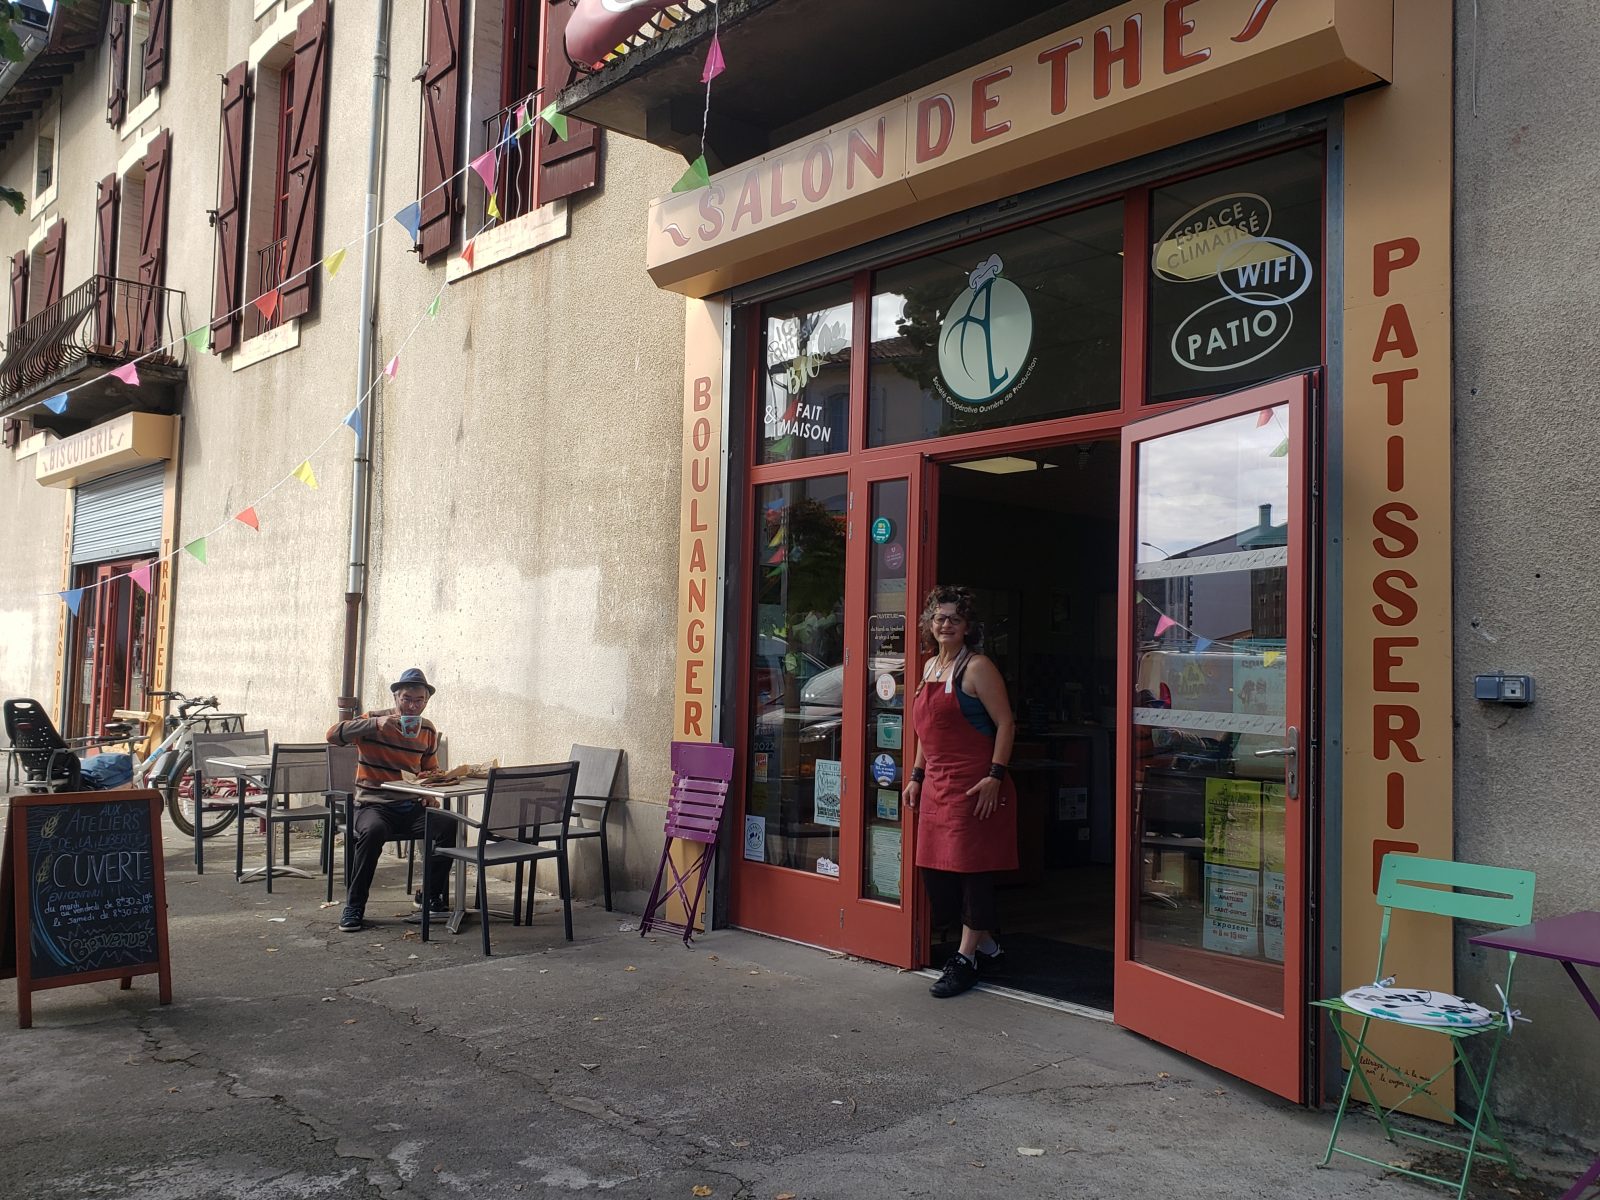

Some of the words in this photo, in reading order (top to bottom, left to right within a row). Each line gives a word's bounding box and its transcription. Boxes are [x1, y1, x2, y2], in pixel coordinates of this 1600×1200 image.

[698, 116, 887, 244] SALON
[916, 65, 1013, 165] DE
[1174, 201, 1245, 247] ESPACE
[1166, 210, 1261, 270] CLIMATISÉ
[1237, 254, 1297, 290] WIFI
[1187, 309, 1278, 361] PATIO
[785, 348, 822, 396] BIO
[932, 375, 948, 399] Société
[945, 396, 979, 415] Coopérative
[1004, 392, 1014, 403] de
[1012, 356, 1039, 395] Production
[763, 404, 777, 425] &
[795, 402, 823, 421] FAIT
[779, 418, 832, 443] MAISON
[49, 424, 115, 471] BISCUITERIE
[683, 375, 712, 737] BOULANGER
[53, 670, 61, 723] BIO
[64, 808, 142, 834] ATELIERS
[100, 803, 122, 816] AUX
[57, 836, 72, 850] DE
[44, 901, 56, 914] du
[59, 899, 80, 912] mardi
[99, 909, 110, 920] de
[104, 899, 114, 909] de
[1212, 919, 1249, 933] Exposent
